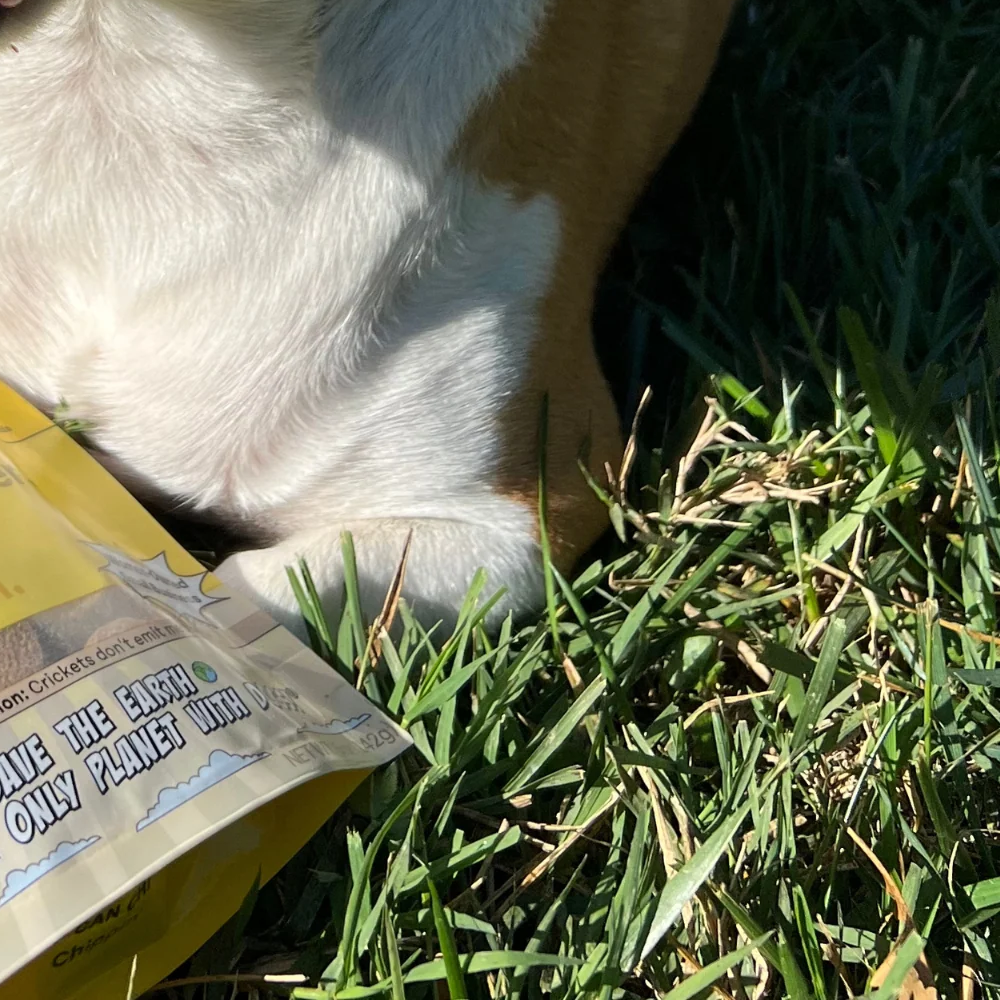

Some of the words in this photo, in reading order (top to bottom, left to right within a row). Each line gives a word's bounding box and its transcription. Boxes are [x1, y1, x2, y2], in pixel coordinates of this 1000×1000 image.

[28, 654, 96, 694] Crickets
[96, 635, 136, 661] don't
[133, 625, 164, 646] emit
[53, 699, 117, 754] THE
[113, 663, 199, 722] EARTH
[4, 770, 81, 845] ONLY
[84, 712, 187, 794] PLANET
[183, 686, 252, 735] WITH
